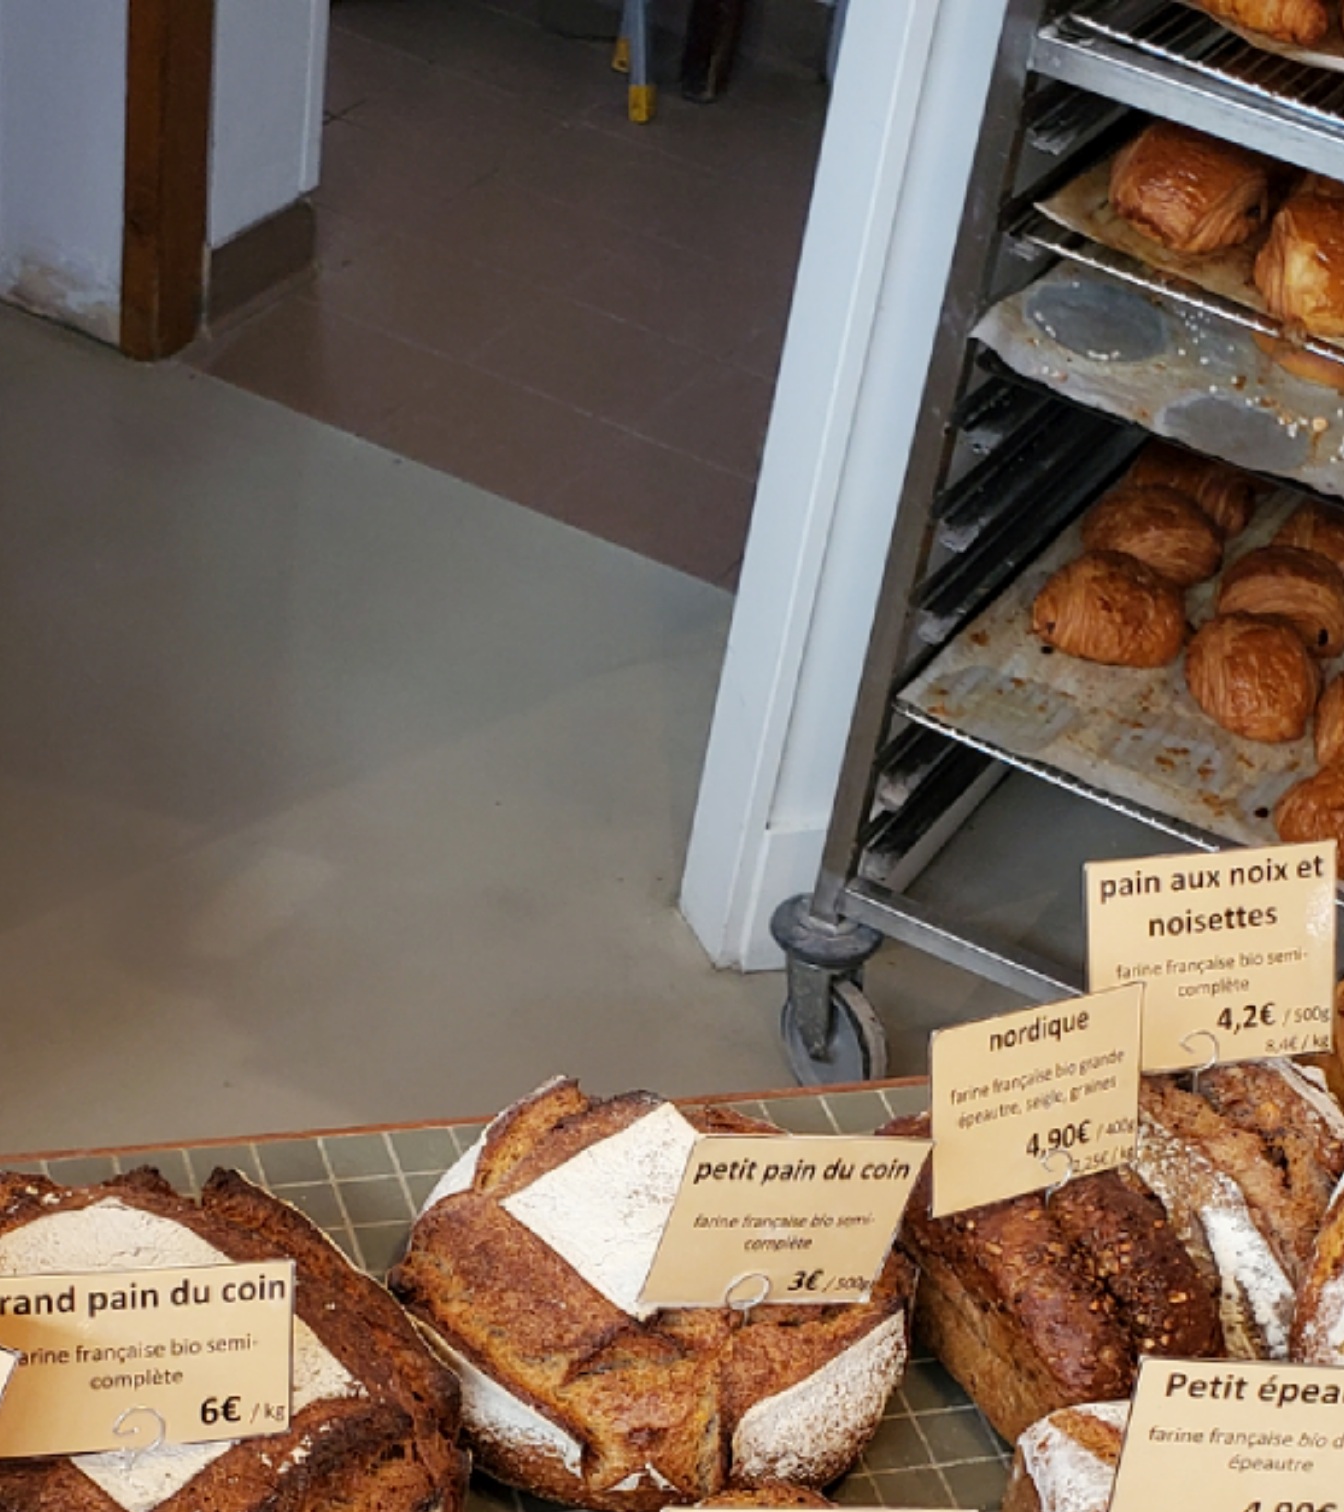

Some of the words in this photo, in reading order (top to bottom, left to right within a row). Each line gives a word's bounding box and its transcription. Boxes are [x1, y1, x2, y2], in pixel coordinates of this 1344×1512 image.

[1100, 871, 1161, 904] pain
[1171, 869, 1220, 891] aux
[1230, 859, 1288, 886] noix
[1297, 855, 1323, 878] et
[1149, 905, 1277, 936] noisettes
[1116, 964, 1162, 980] farine
[1166, 958, 1235, 975] française
[1239, 952, 1262, 967] bio
[1178, 978, 1249, 998] complète
[990, 1011, 1090, 1052] nordique
[1216, 1002, 1276, 1034] 4,2€
[1026, 1119, 1092, 1158] 4,90€
[694, 1158, 756, 1184] petit
[761, 1159, 815, 1185] pain
[823, 1158, 855, 1180] du
[860, 1158, 910, 1181] coin
[787, 1270, 823, 1291] 3€
[88, 1283, 159, 1317] pain
[170, 1279, 210, 1305] du
[222, 1275, 285, 1302] coin
[76, 1342, 166, 1364] française
[170, 1338, 201, 1356] bio
[206, 1333, 258, 1353] semi-
[90, 1368, 183, 1392] complète
[1165, 1372, 1248, 1401] Petit
[201, 1396, 241, 1425] 6€
[264, 1401, 285, 1421] kg
[1149, 1426, 1204, 1444] farine
[1209, 1428, 1294, 1449] française
[1297, 1432, 1327, 1448] bio
[1228, 1454, 1314, 1474] épeautre
